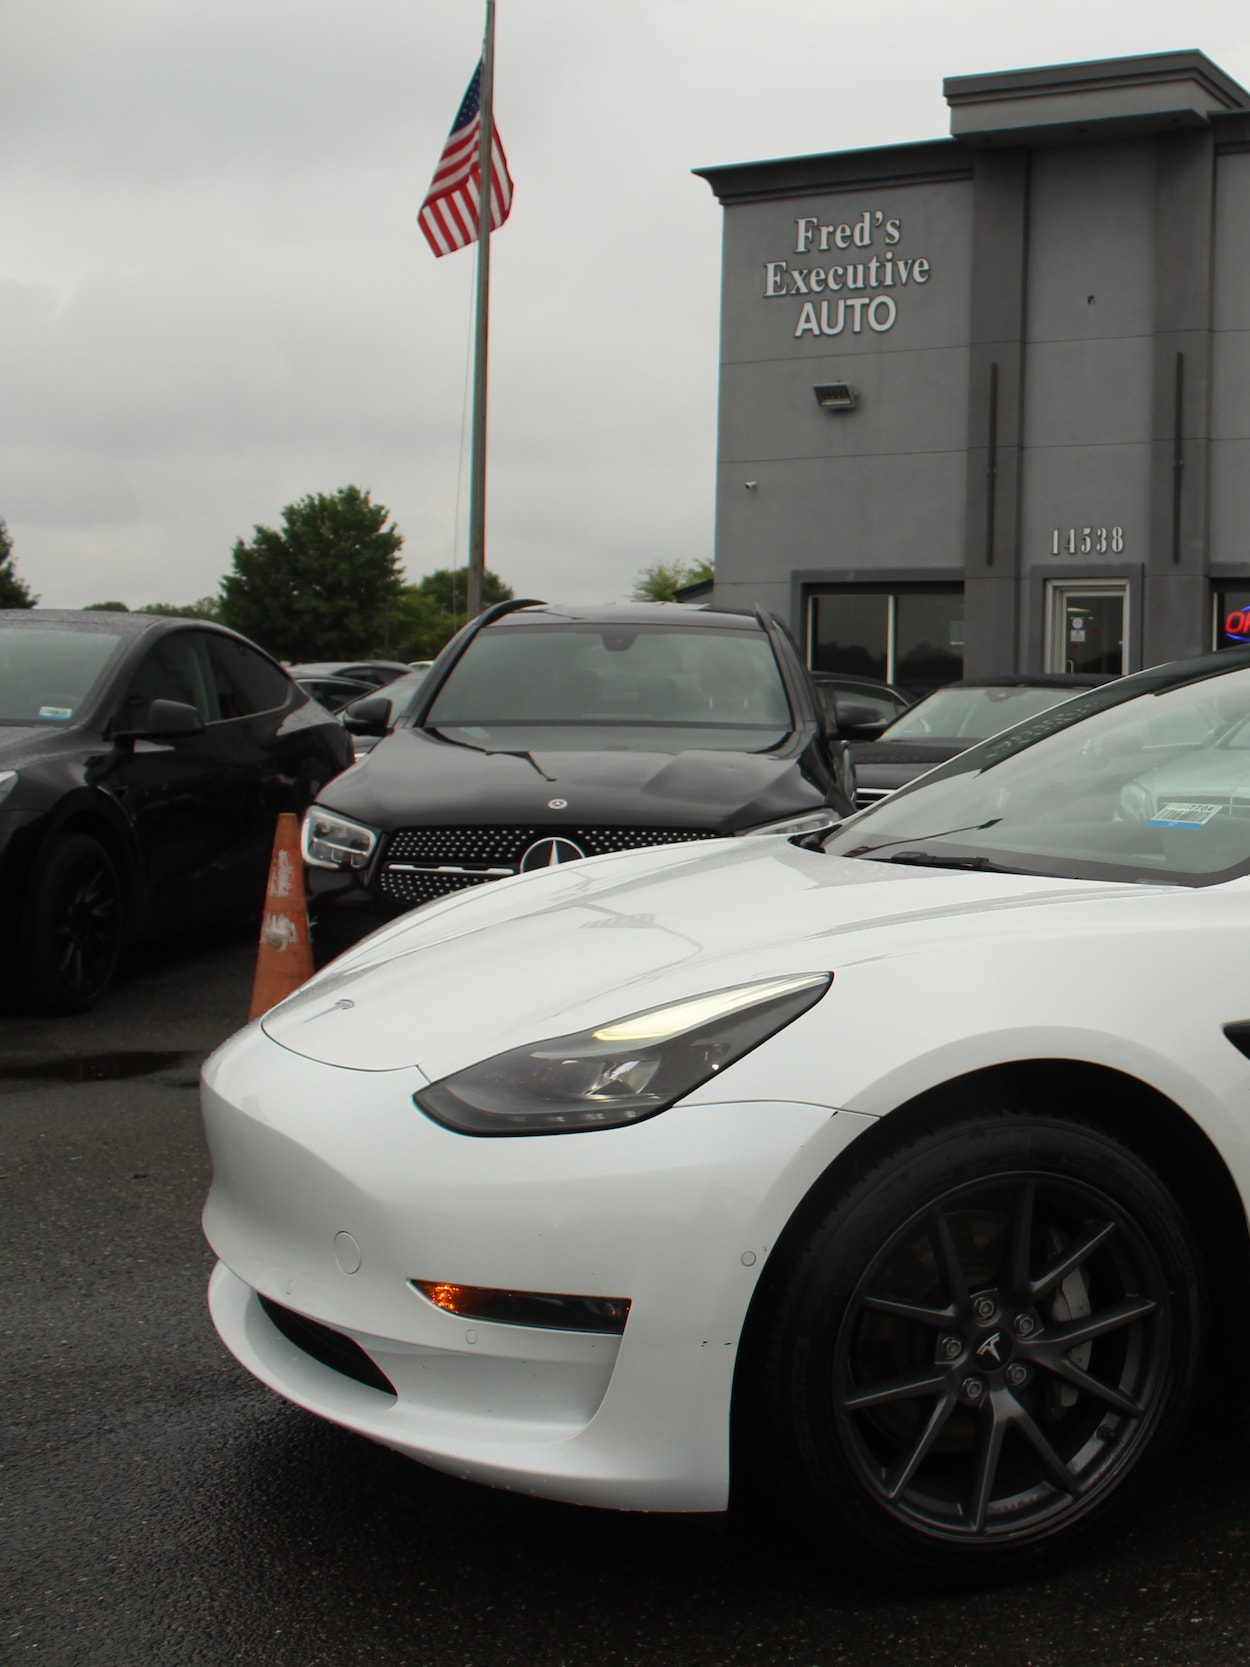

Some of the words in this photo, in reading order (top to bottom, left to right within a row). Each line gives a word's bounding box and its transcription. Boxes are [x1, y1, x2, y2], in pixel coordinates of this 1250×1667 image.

[794, 210, 901, 253] Fred's
[763, 251, 930, 297] Executive
[794, 294, 897, 337] AUTO
[1051, 526, 1124, 554] 14538
